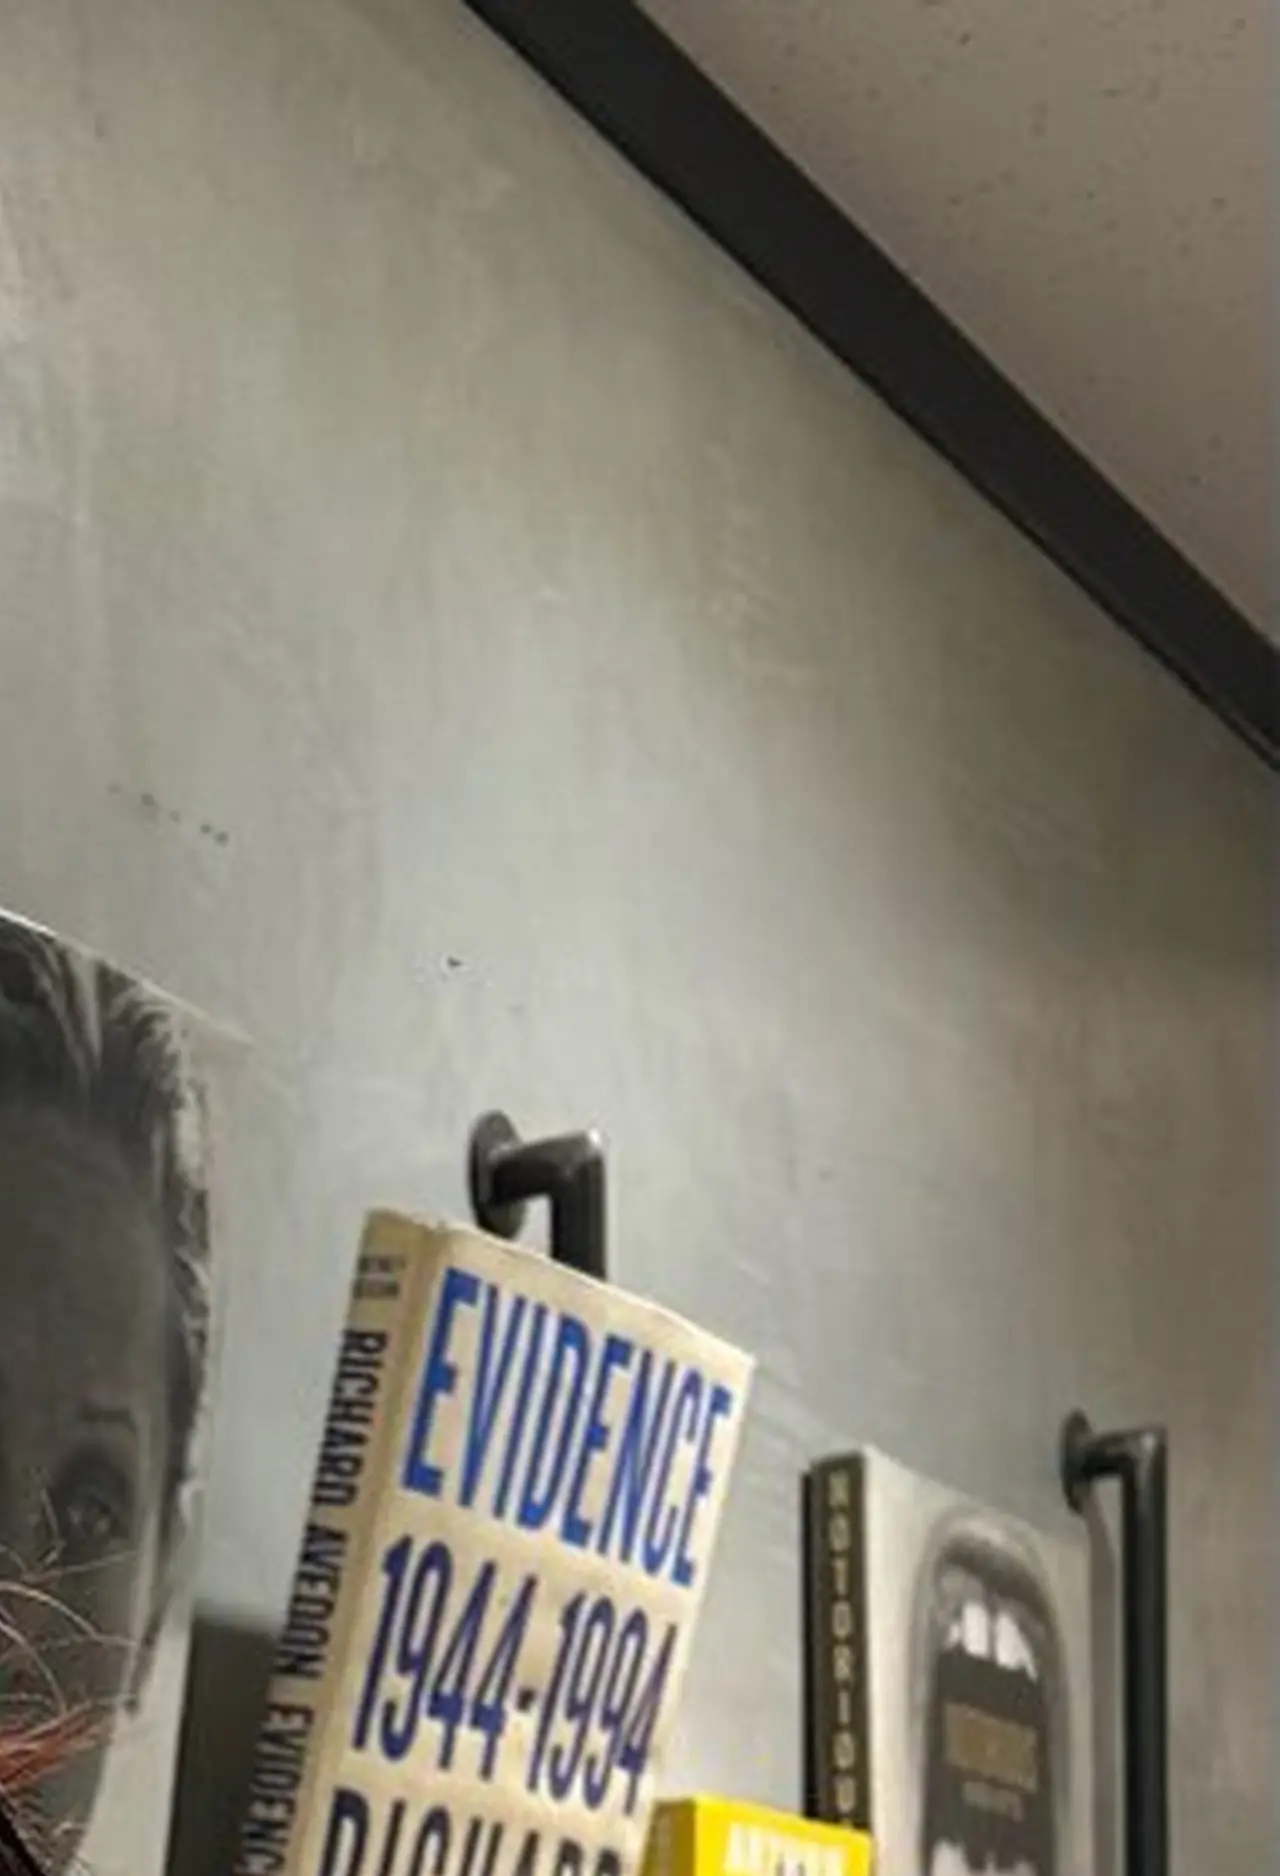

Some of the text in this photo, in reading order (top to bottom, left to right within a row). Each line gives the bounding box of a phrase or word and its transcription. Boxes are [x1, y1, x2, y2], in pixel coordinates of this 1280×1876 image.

[314, 1328, 387, 1510] RICHARD
[402, 1267, 734, 1589] EVIDENCE
[273, 1522, 349, 1680] AVEDON
[352, 1535, 679, 1818] 1944-1994
